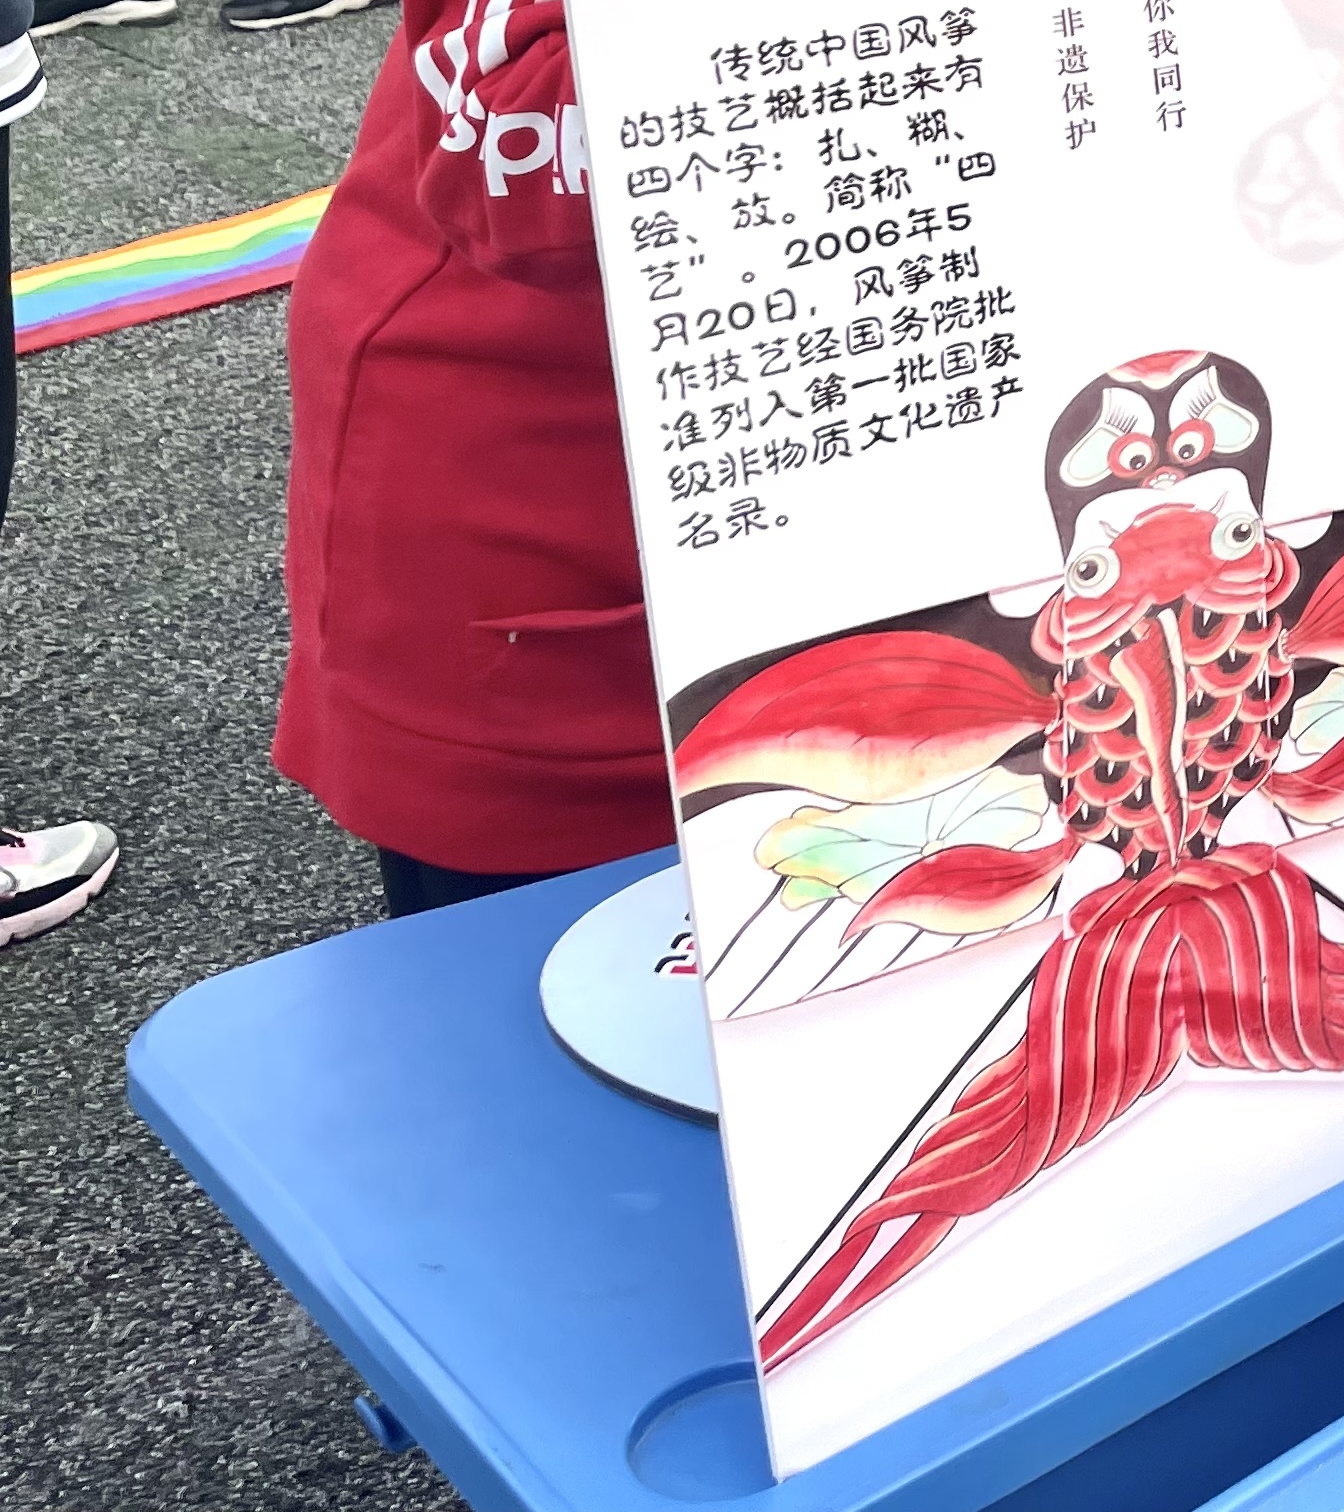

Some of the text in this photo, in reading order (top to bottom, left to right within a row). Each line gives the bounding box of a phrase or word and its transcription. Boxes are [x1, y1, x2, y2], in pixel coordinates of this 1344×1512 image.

[620, 54, 984, 149] 的技艺概括起来有
[709, 7, 978, 86] 传统中国风筝
[1052, 7, 1097, 150] 非遗保护
[656, 286, 1017, 402] 作技艺经国务院批
[660, 333, 1022, 451] 准列入第一批国家
[668, 376, 1025, 503] 级非物质文化遗产
[677, 497, 790, 550] 名录。
